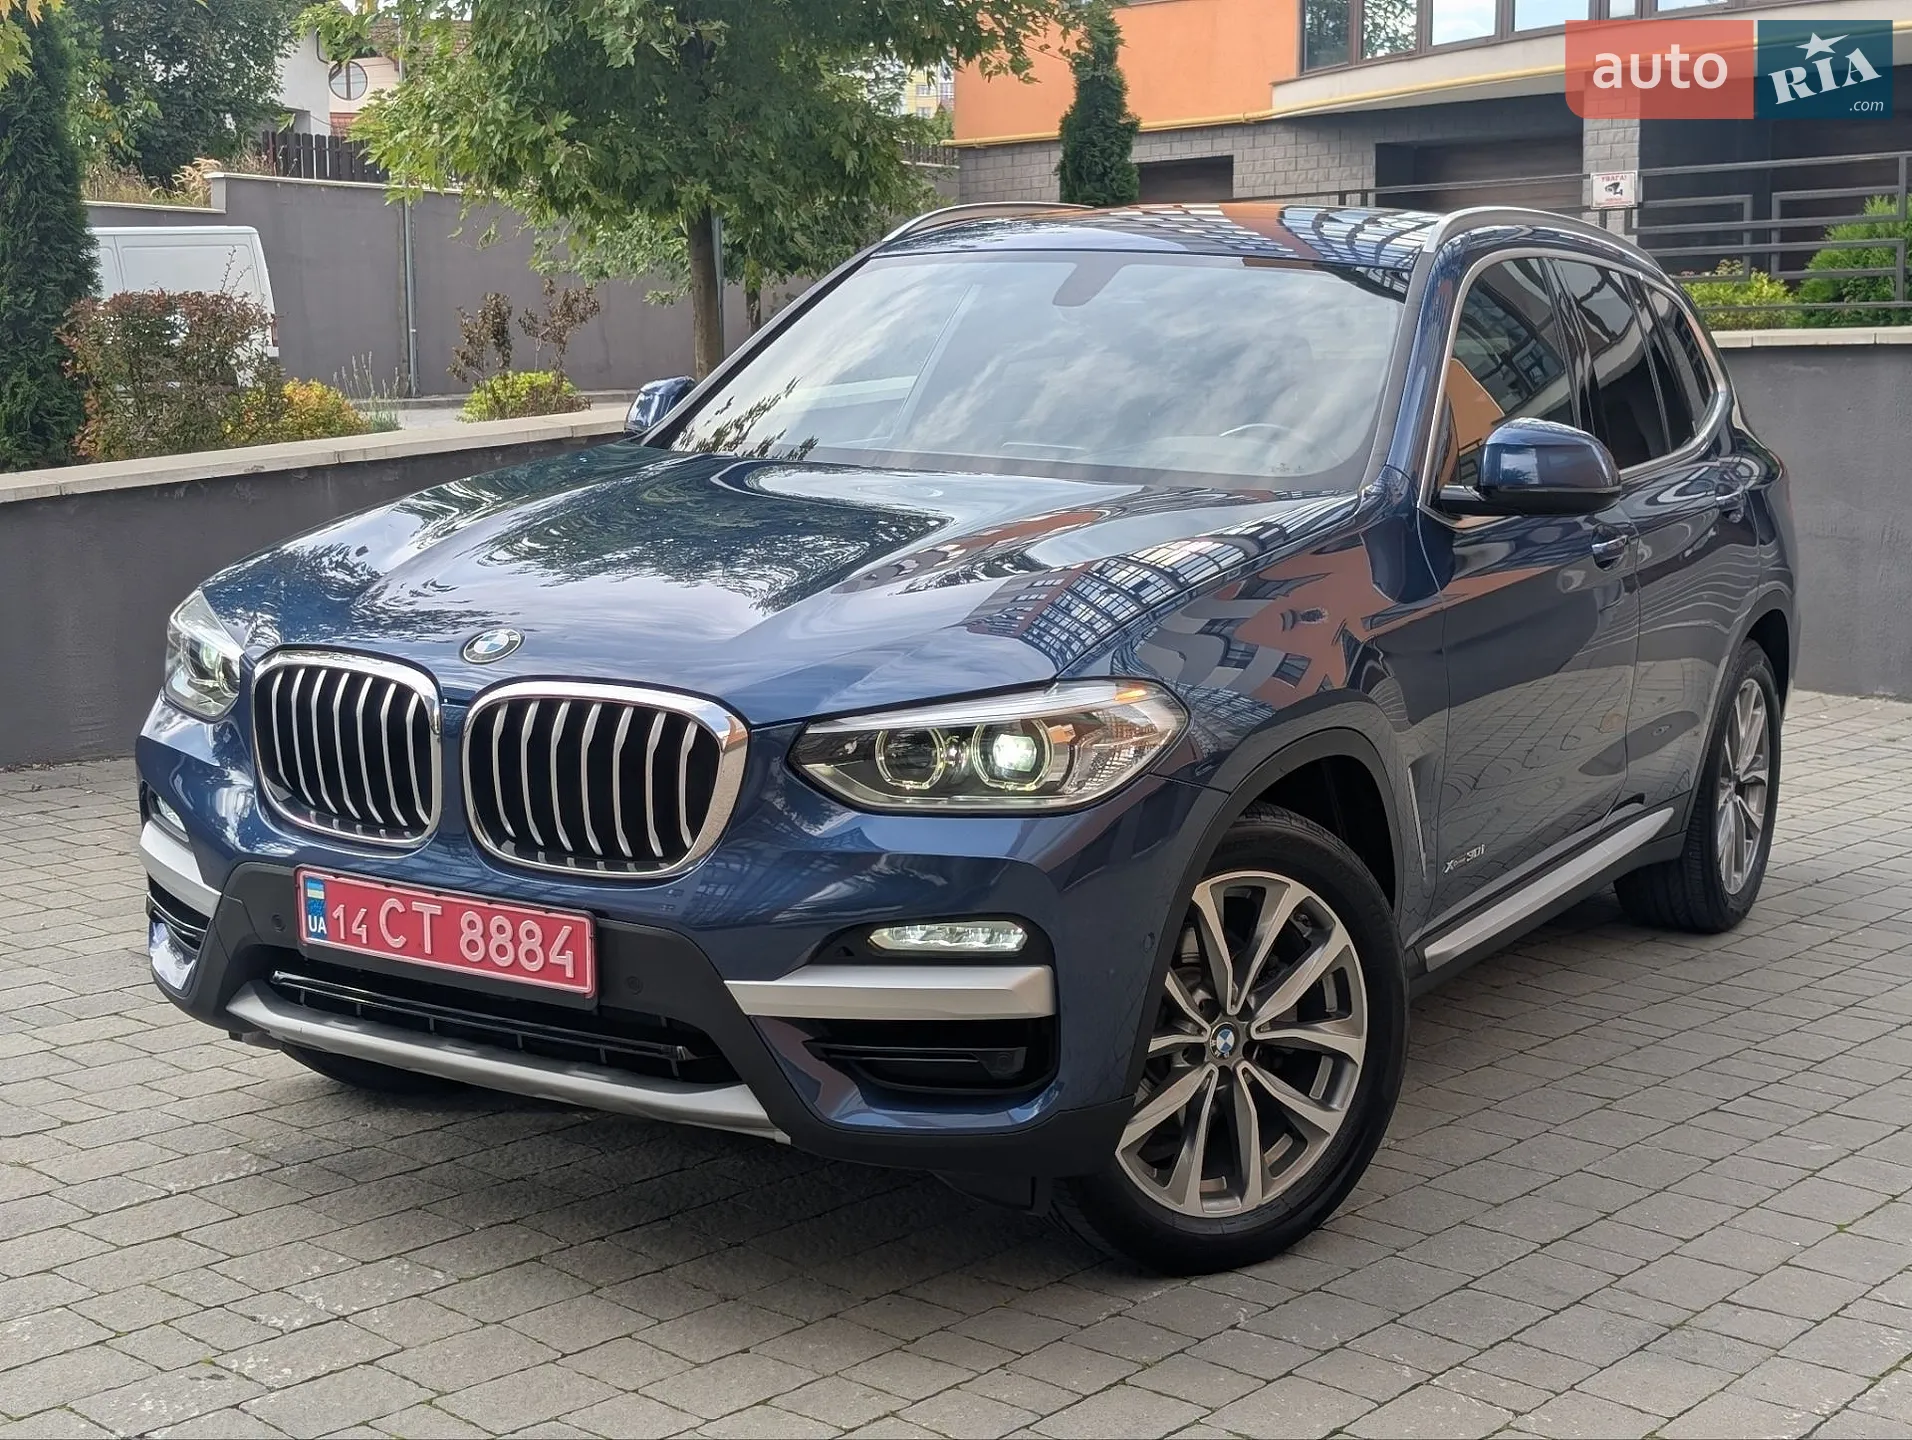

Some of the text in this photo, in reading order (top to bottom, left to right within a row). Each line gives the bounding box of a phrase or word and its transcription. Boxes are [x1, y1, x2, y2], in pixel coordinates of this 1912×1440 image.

[308, 914, 328, 935] UA
[331, 897, 575, 979] 14 CT 8884
